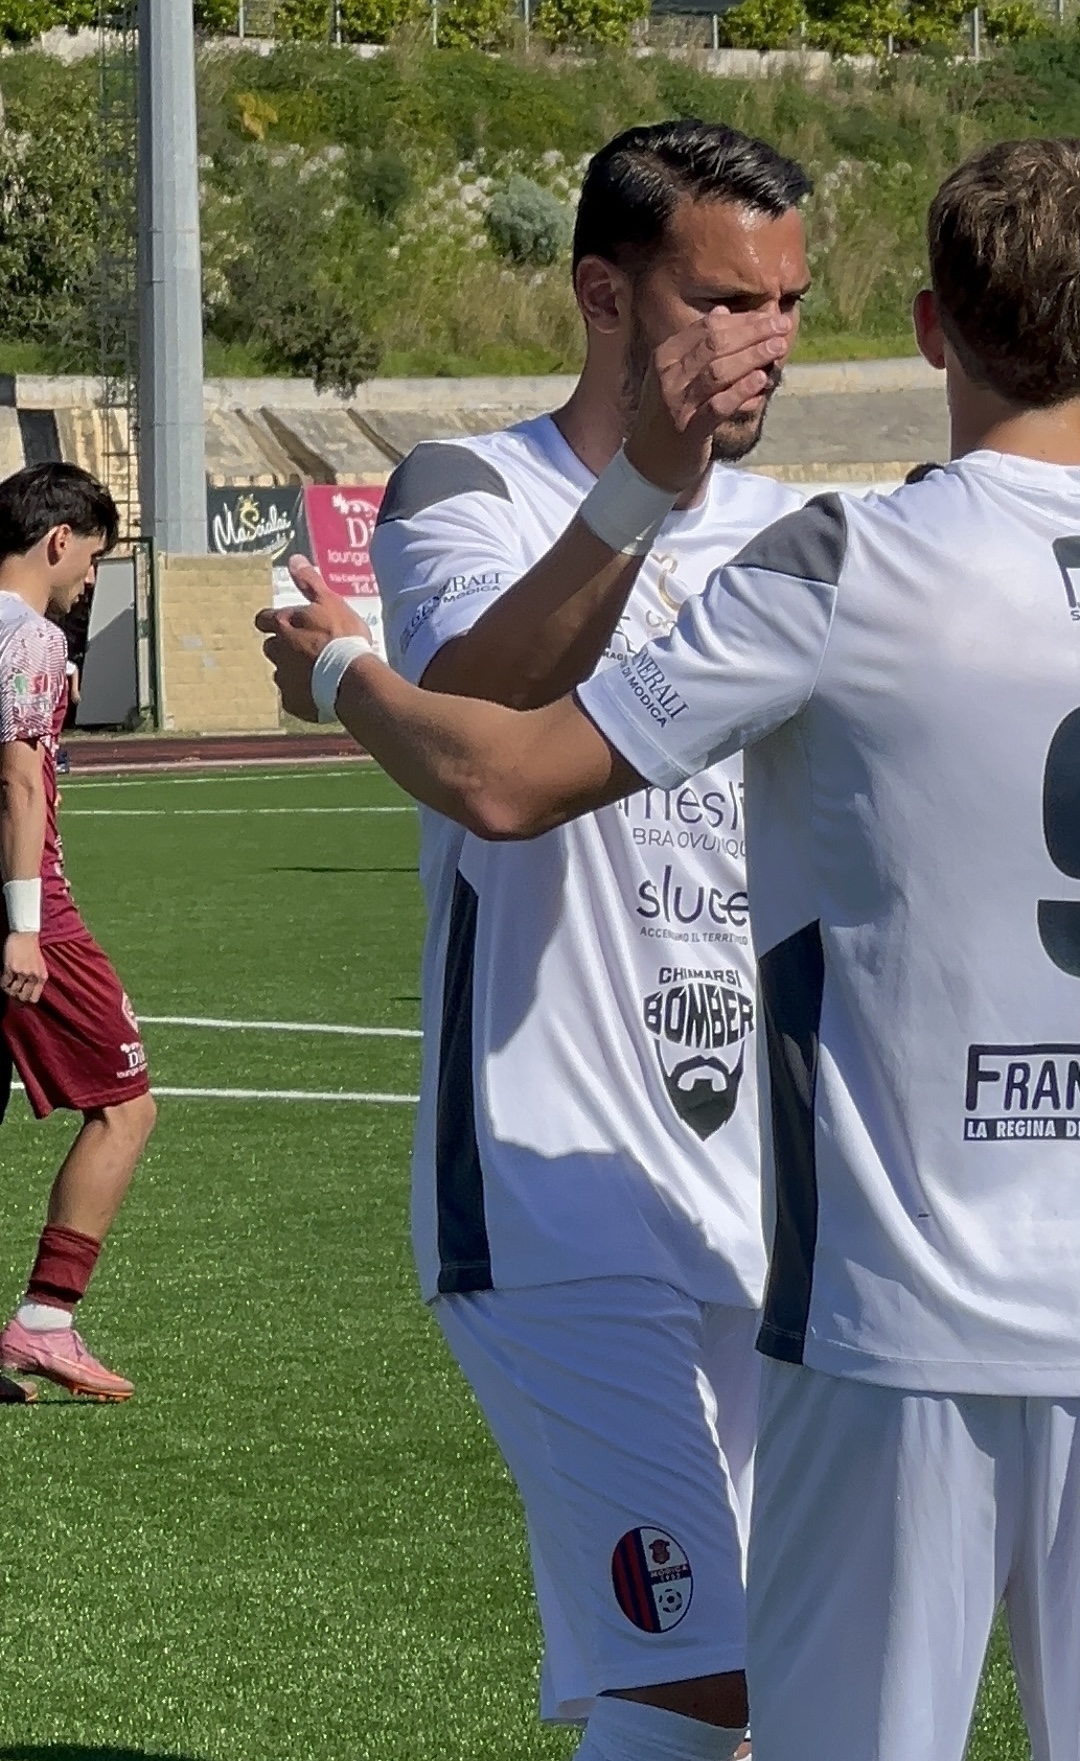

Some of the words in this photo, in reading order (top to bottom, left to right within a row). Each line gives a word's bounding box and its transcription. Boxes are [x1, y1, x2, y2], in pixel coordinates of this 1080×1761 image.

[628, 676, 669, 728] MODICA
[632, 649, 689, 720] NERALI
[659, 967, 742, 988] CHIAMARSI
[643, 983, 755, 1049] BOMBER
[967, 1121, 987, 1138] LA
[996, 1120, 1056, 1137] REGINA
